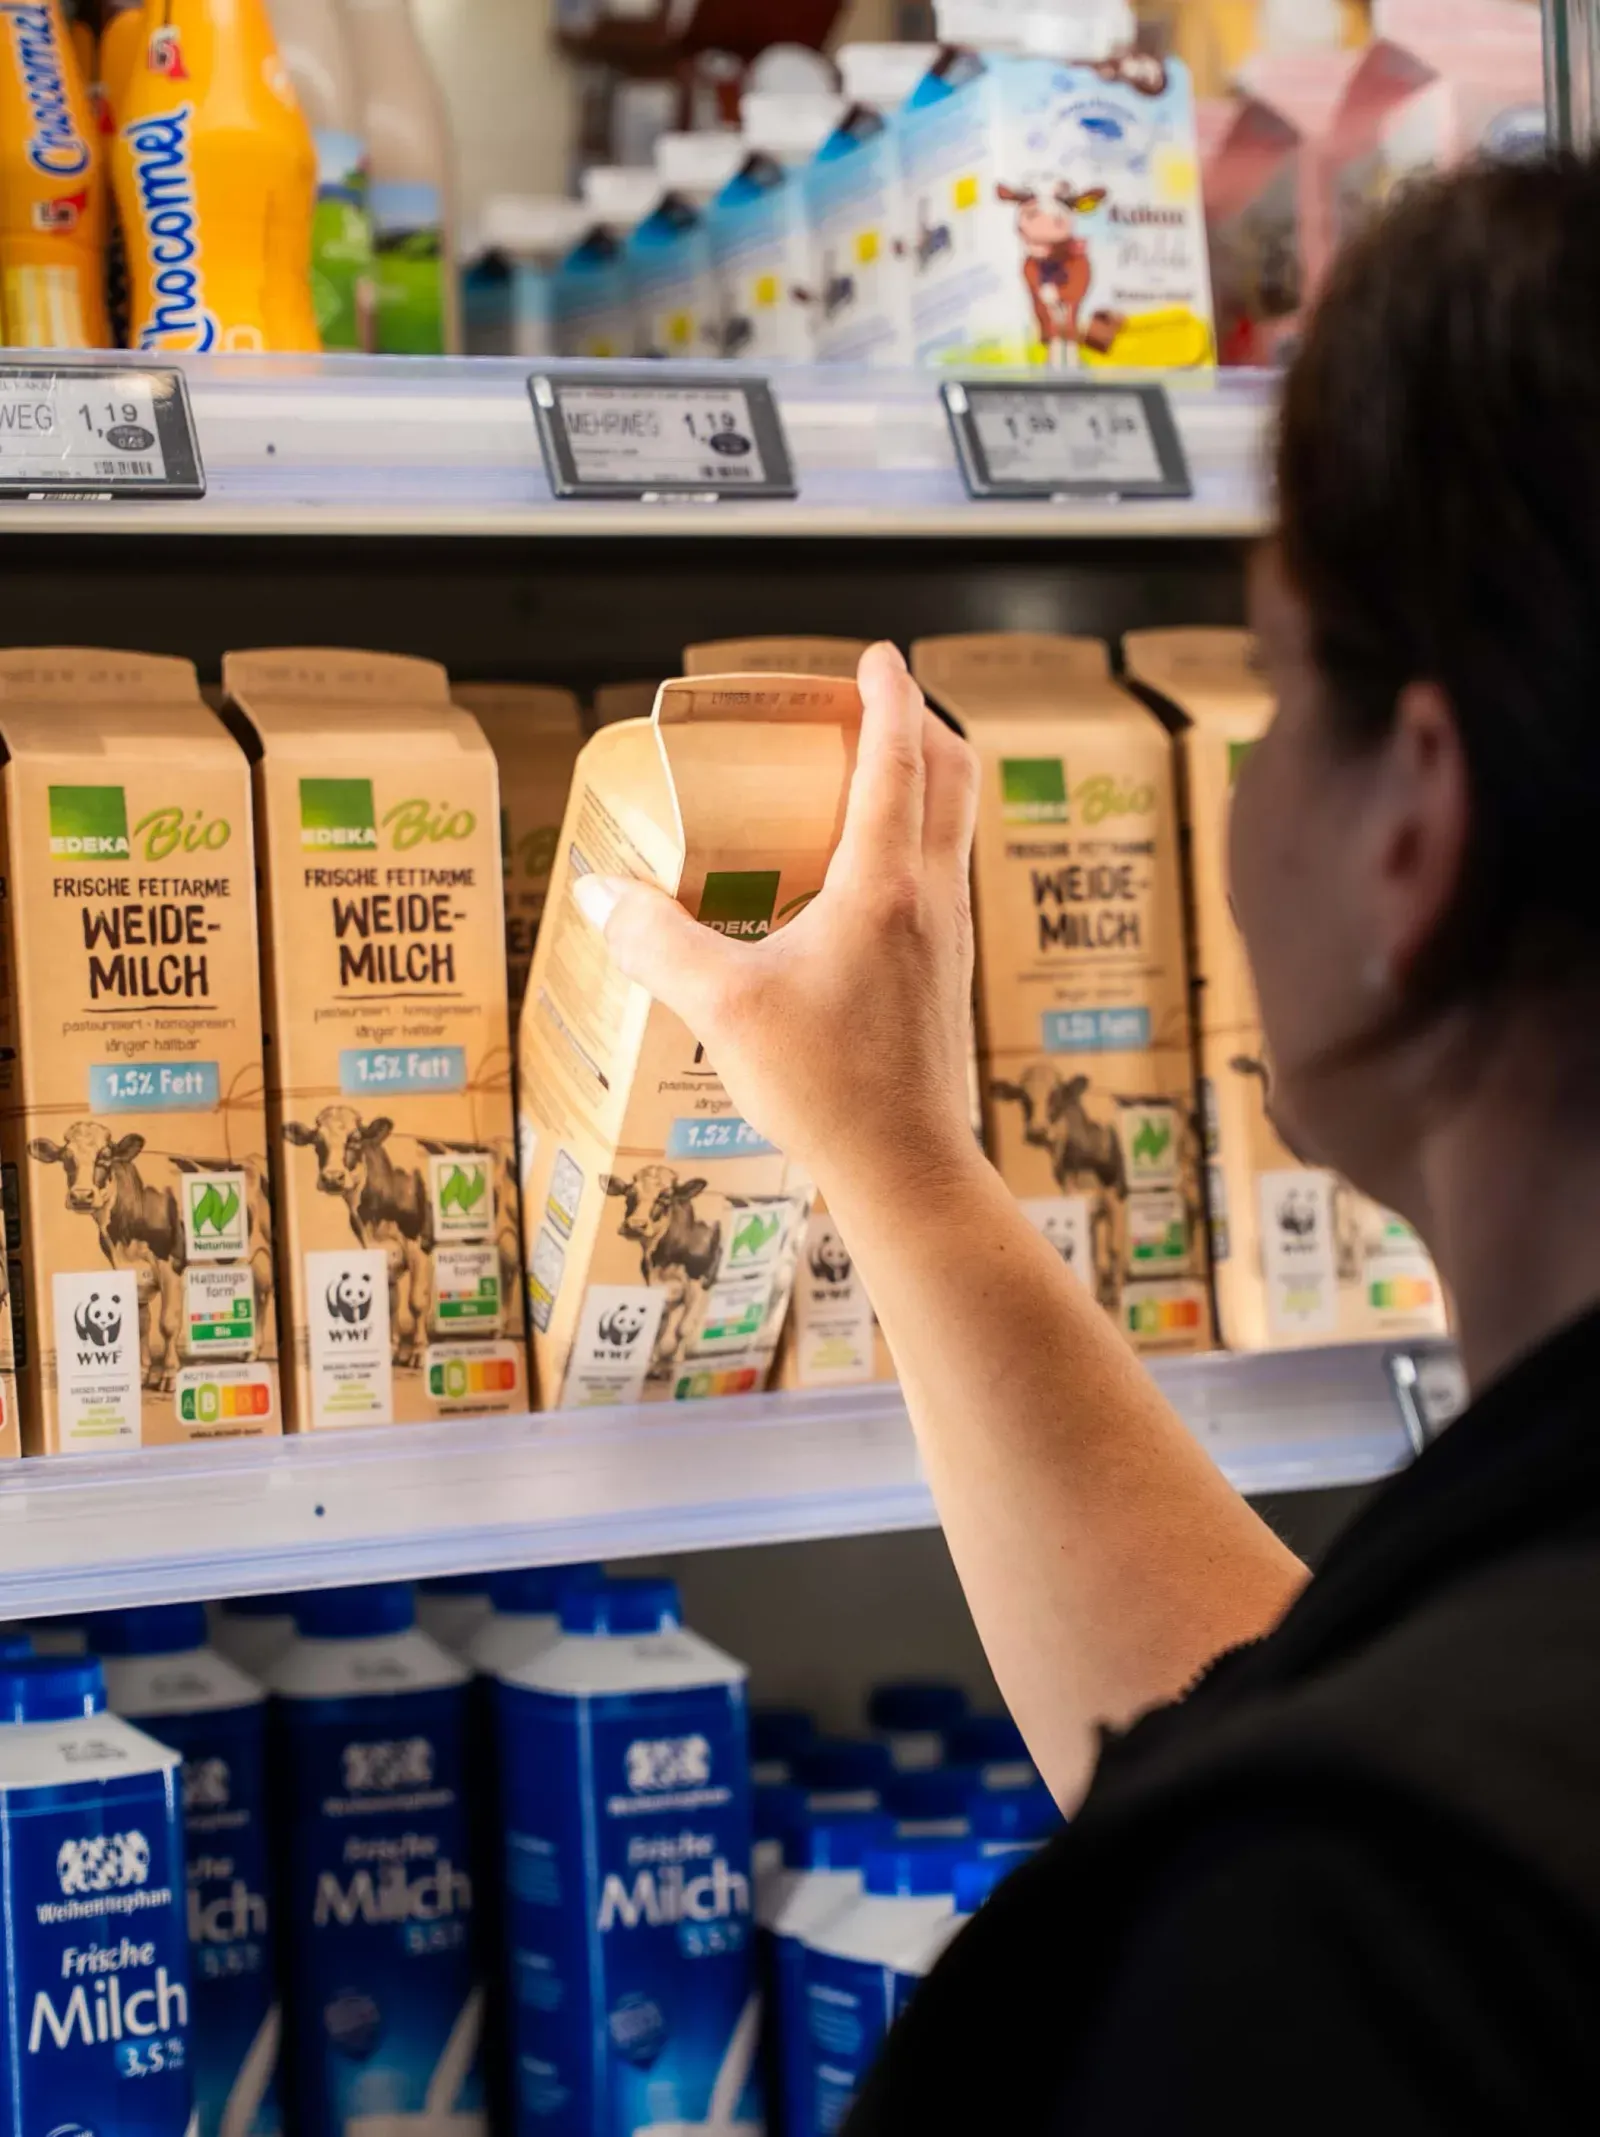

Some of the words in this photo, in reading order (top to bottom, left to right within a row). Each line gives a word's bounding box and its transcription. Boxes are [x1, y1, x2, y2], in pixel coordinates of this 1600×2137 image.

[79, 402, 138, 438] 1,19
[50, 837, 130, 854] EDEKA
[133, 807, 232, 862] Bio
[382, 799, 477, 852] Bio
[53, 877, 131, 898] FRISCHE
[139, 877, 231, 897] FETTARME
[304, 868, 378, 888] FRISCHE
[386, 868, 476, 887] FETTARME
[82, 903, 223, 950] WEIDE-
[332, 893, 467, 939] WEIDE-
[1038, 909, 1141, 951] MILCH
[89, 953, 210, 1000] MILCH
[338, 942, 456, 987] MILCH
[160, 1068, 205, 1095] Fett
[77, 1350, 122, 1366] WWF
[313, 1858, 473, 1928] Milch
[597, 1857, 750, 1932] Milch
[61, 1937, 157, 1979] Frische
[28, 1966, 189, 2054] Milch
